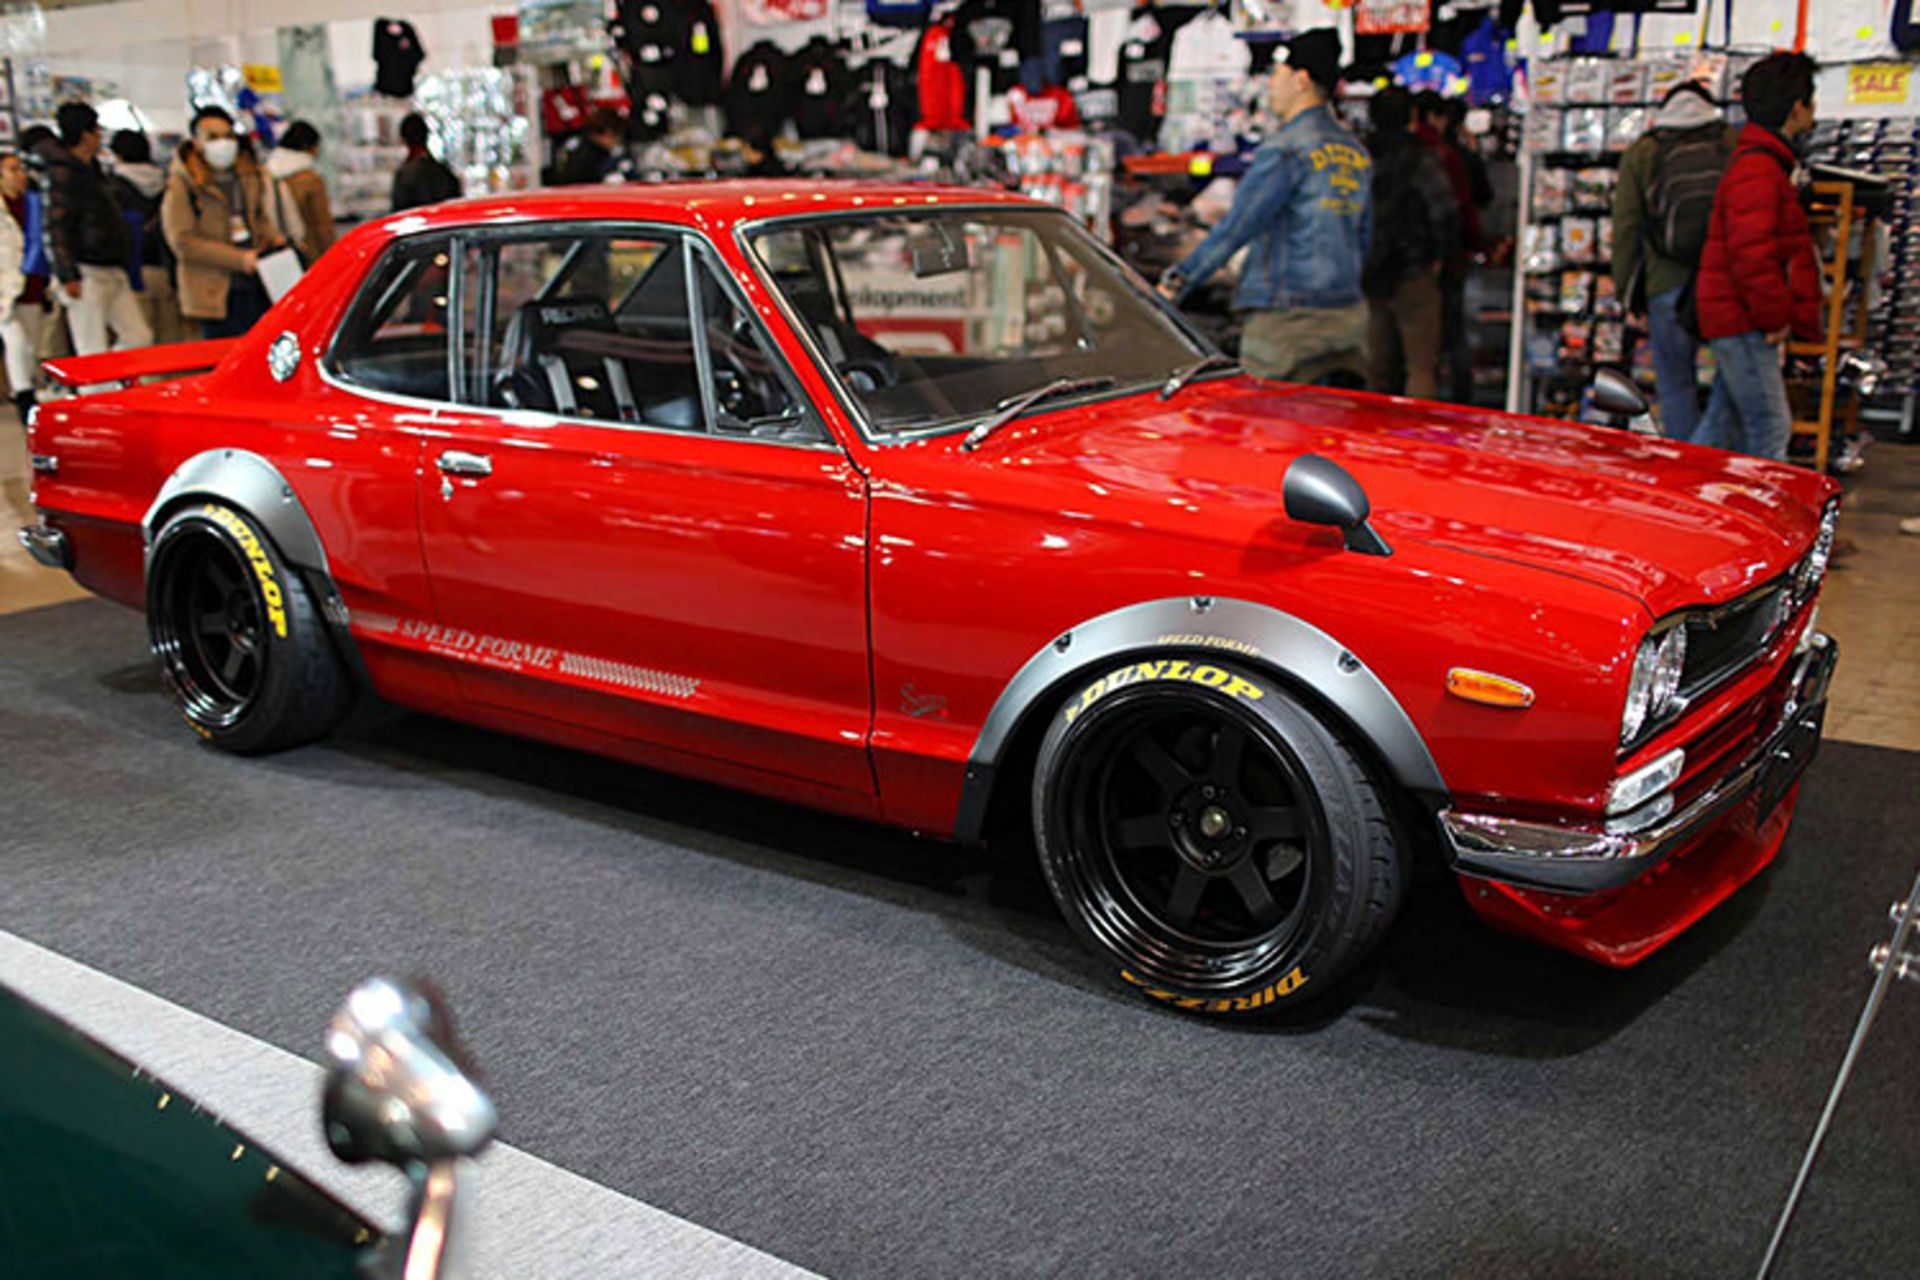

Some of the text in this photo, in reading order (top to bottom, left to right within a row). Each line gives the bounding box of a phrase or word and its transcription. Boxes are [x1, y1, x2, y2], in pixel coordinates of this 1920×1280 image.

[1852, 71, 1907, 93] SALE
[210, 506, 287, 638] DUNLOP
[402, 619, 475, 650] SPEED
[1079, 660, 1264, 713] DUNLOP
